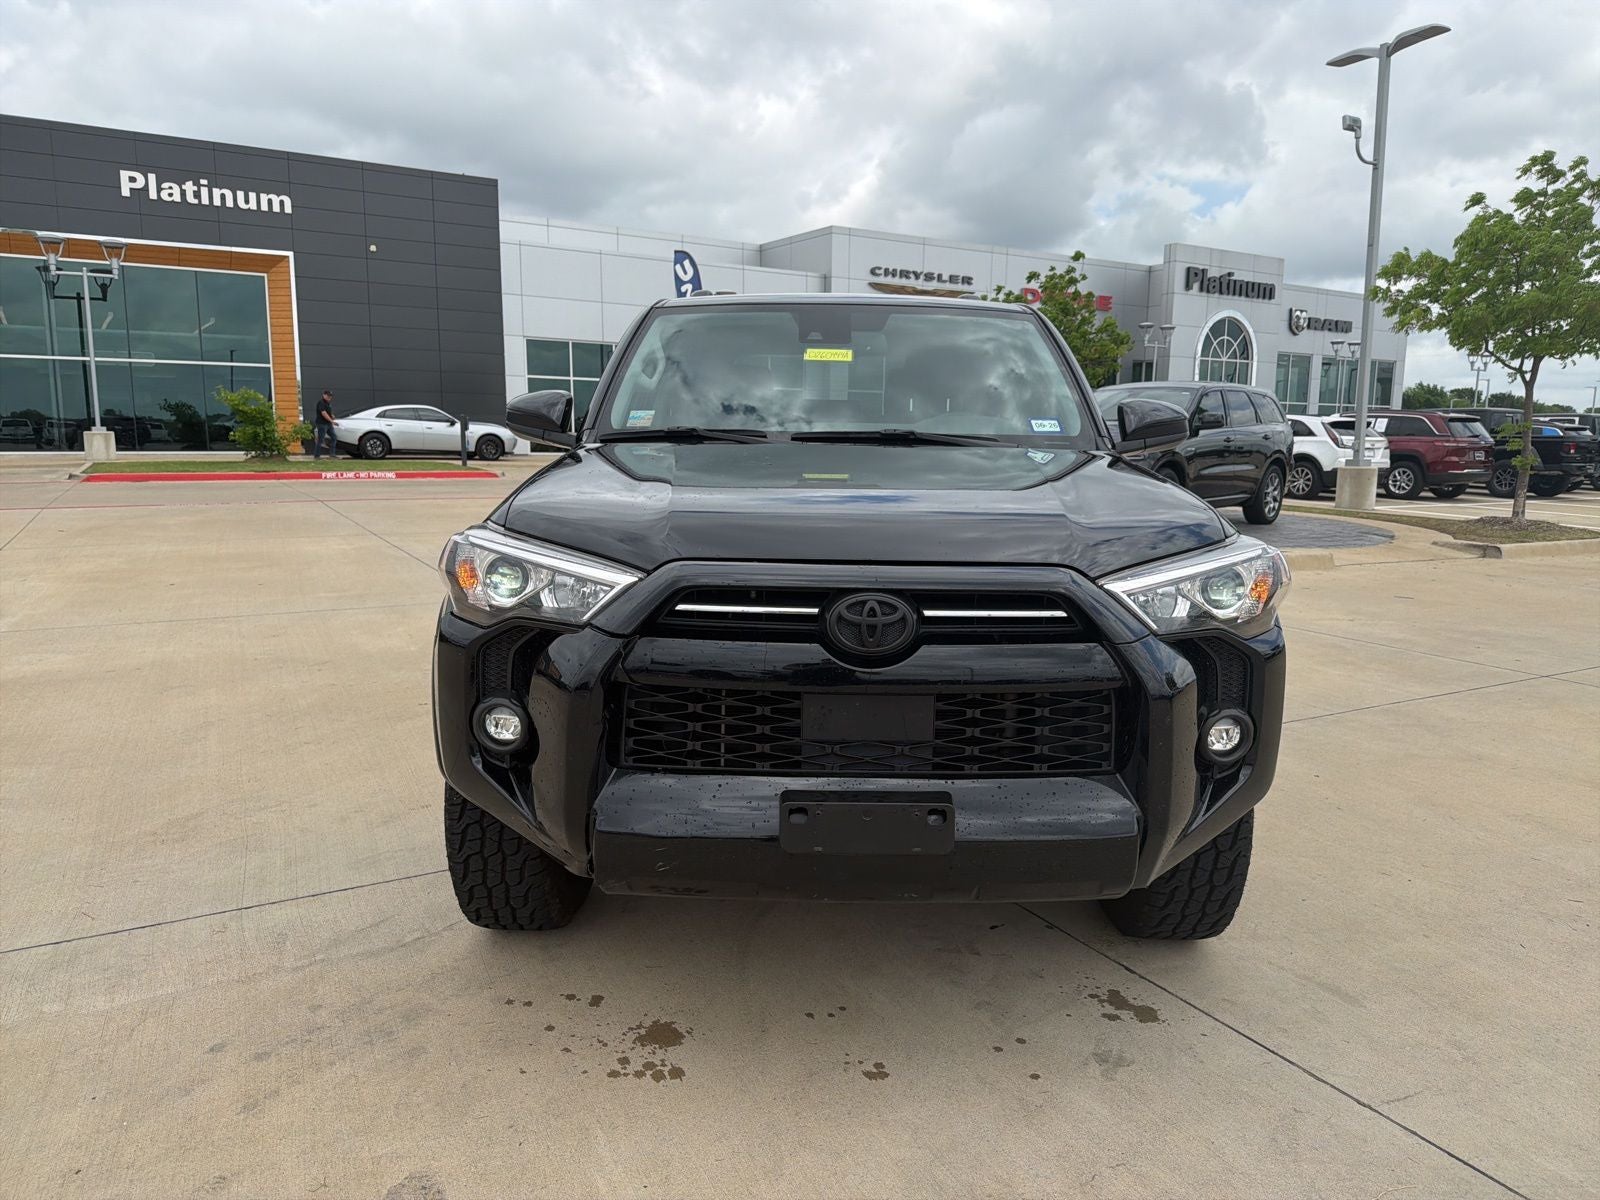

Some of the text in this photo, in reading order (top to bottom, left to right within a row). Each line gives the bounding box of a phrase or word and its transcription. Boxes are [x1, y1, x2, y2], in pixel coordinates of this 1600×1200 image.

[119, 169, 293, 214] Platinum
[870, 266, 974, 286] CHRYSLER
[1185, 266, 1276, 301] Platinum
[1307, 316, 1353, 333] RAM
[321, 471, 336, 479] FIRE
[338, 471, 356, 479] LANE
